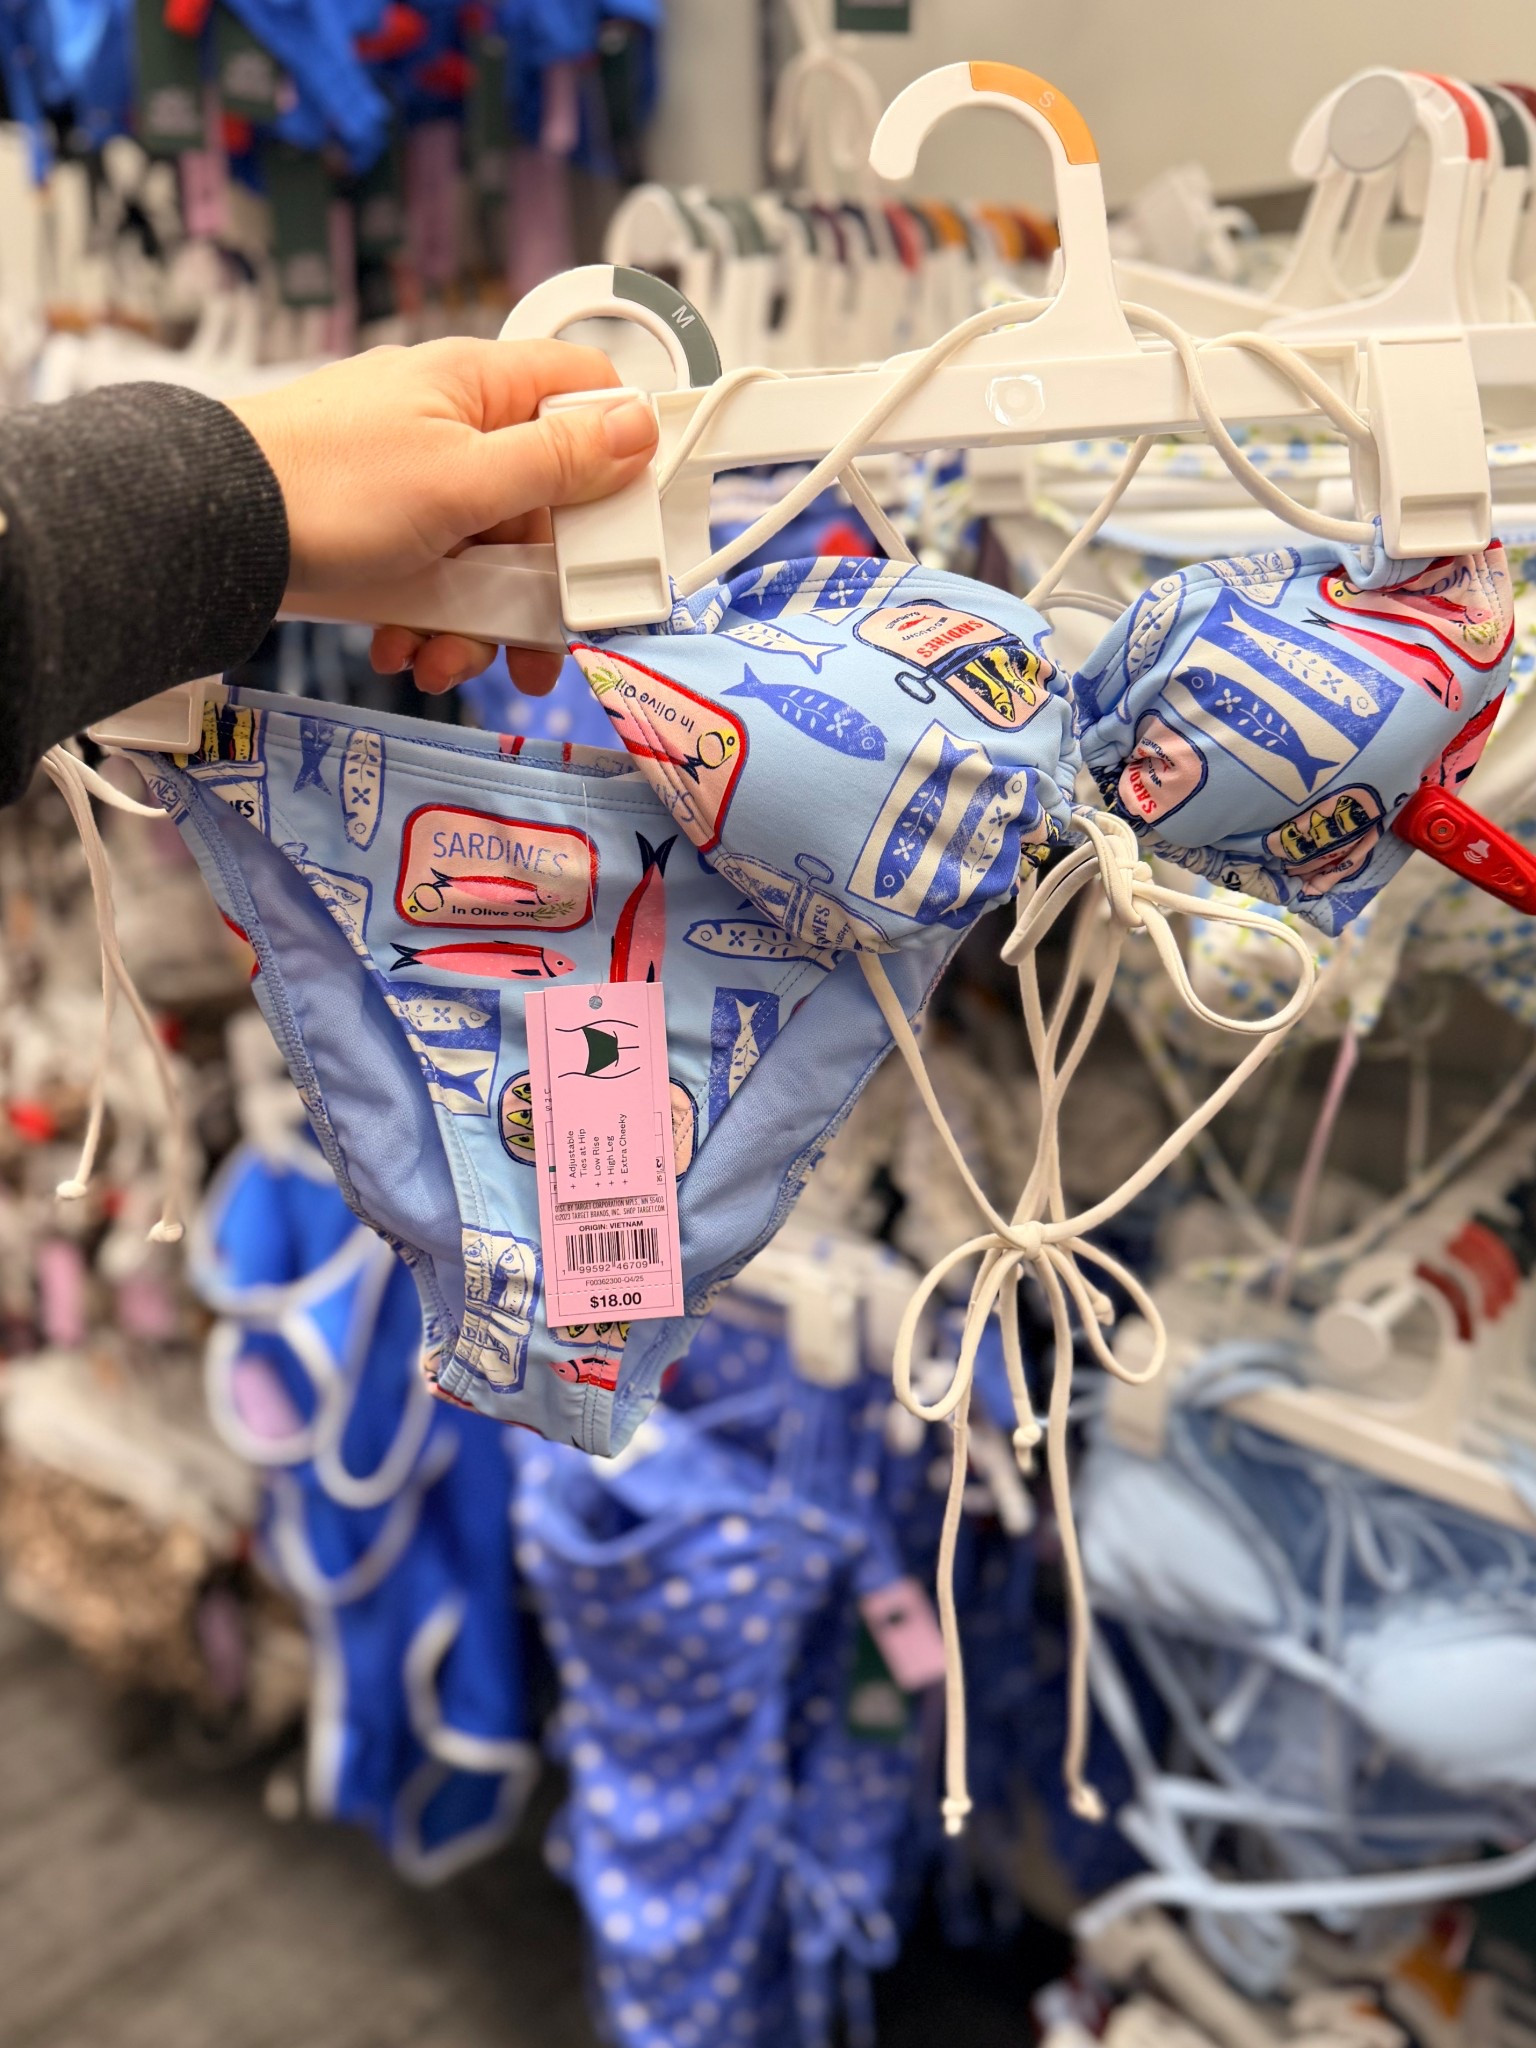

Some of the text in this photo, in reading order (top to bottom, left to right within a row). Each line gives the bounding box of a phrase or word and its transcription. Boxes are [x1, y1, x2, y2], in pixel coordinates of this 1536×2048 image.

[1038, 91, 1055, 108] S
[671, 305, 696, 329] M
[916, 619, 984, 658] SARDINES
[640, 692, 676, 722] Olive
[681, 716, 695, 733] In
[432, 831, 569, 879] SARDINES
[452, 905, 466, 915] In
[470, 905, 509, 917] Olive
[580, 1146, 587, 1156] at
[618, 1113, 629, 1174] Extra Cheeky
[567, 1130, 577, 1178] Adjustable
[606, 1135, 616, 1175] High Leg
[567, 1203, 573, 1211] BY
[574, 1201, 591, 1211] TARGET
[592, 1198, 624, 1209] CORPORATION
[572, 1211, 589, 1219] TARGET
[579, 1220, 644, 1232] ORIGIN: VIETNAM
[579, 1264, 611, 1274] 99592
[616, 1261, 648, 1270] 46709
[590, 1292, 642, 1309] $18.00
